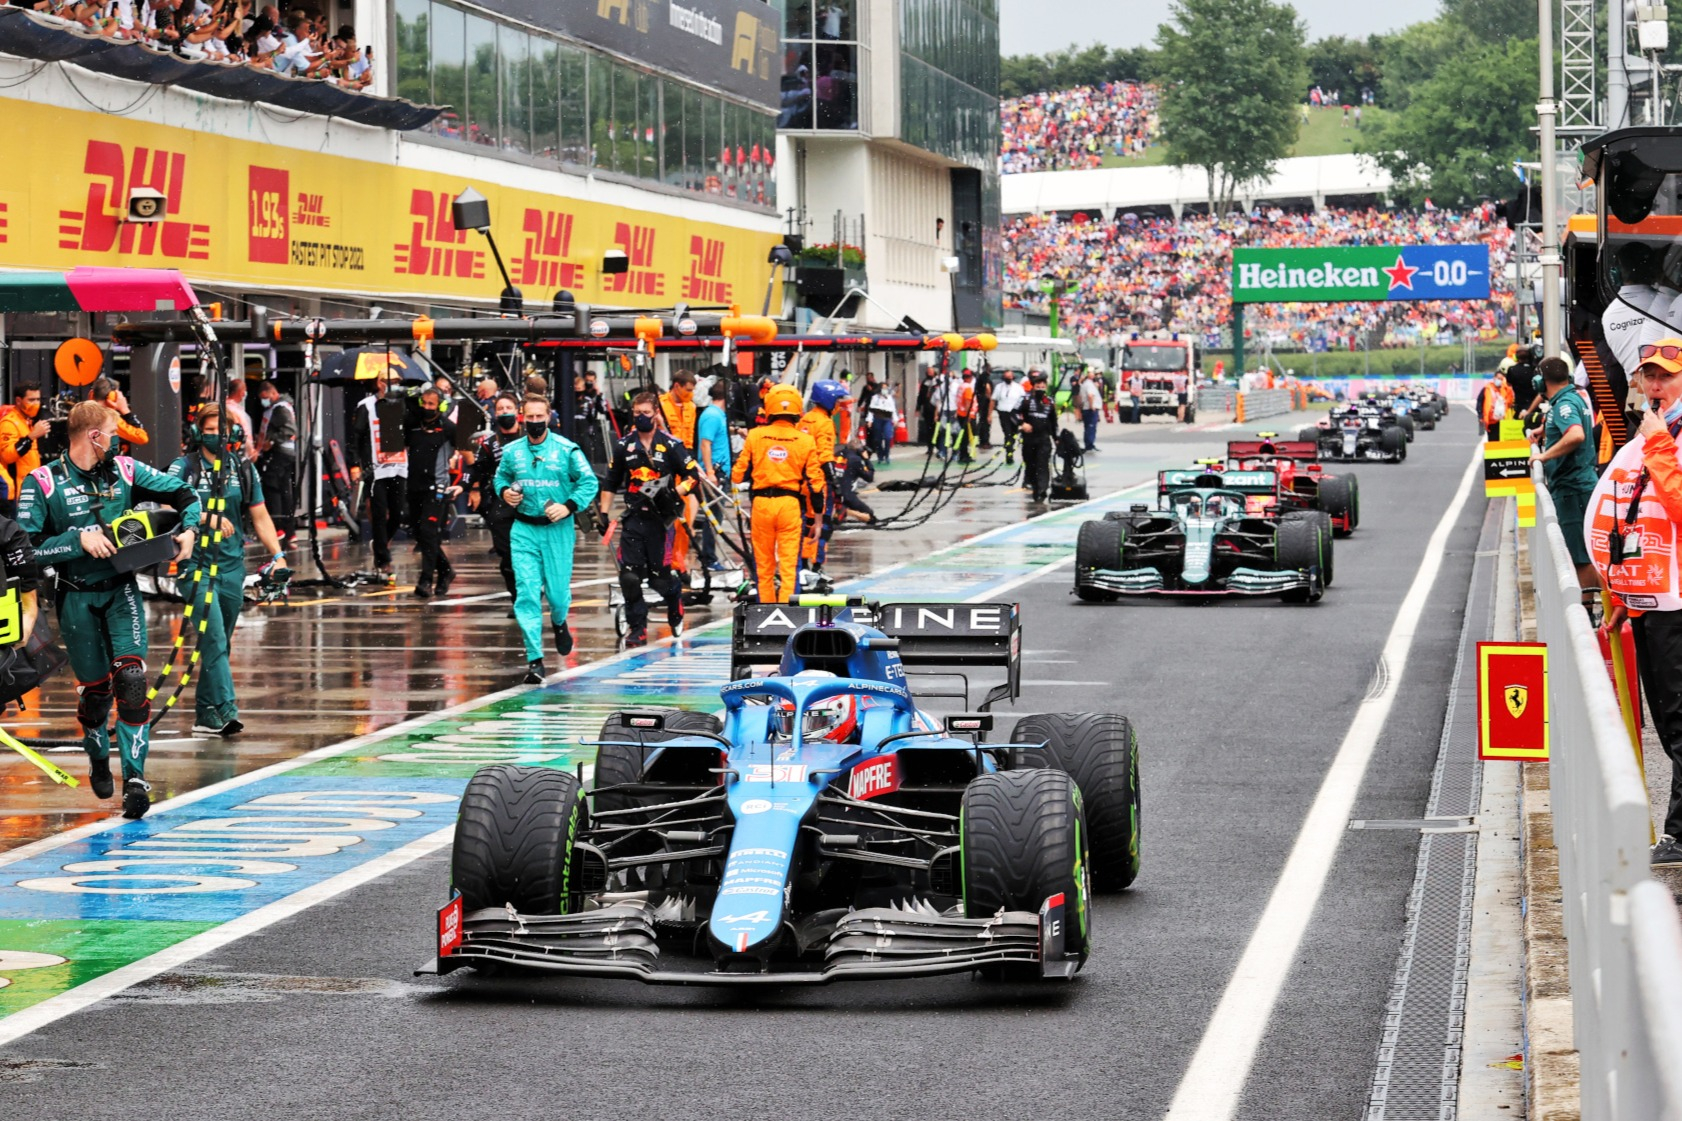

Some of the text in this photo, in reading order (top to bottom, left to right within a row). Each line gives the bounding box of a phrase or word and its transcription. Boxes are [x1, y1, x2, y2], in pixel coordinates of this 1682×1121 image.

[80, 139, 191, 260] DHL
[297, 192, 325, 227] DHL
[408, 188, 486, 279] DHL
[521, 208, 575, 289] DHL
[291, 240, 318, 267] FASTEST
[320, 242, 332, 268] PIT
[333, 244, 348, 269] STOP
[613, 222, 657, 296] DHL
[688, 235, 733, 304] DHL
[1238, 262, 1379, 289] Heineken
[768, 449, 786, 458] Gulf
[1171, 472, 1267, 486] Cozant
[44, 545, 72, 556] MARTIN
[124, 583, 141, 646] ASTON MARTIN
[745, 764, 808, 782] 31
[853, 762, 892, 799] MAPFRE
[724, 877, 782, 887] MAPFRE
[740, 868, 784, 878] Microsoft
